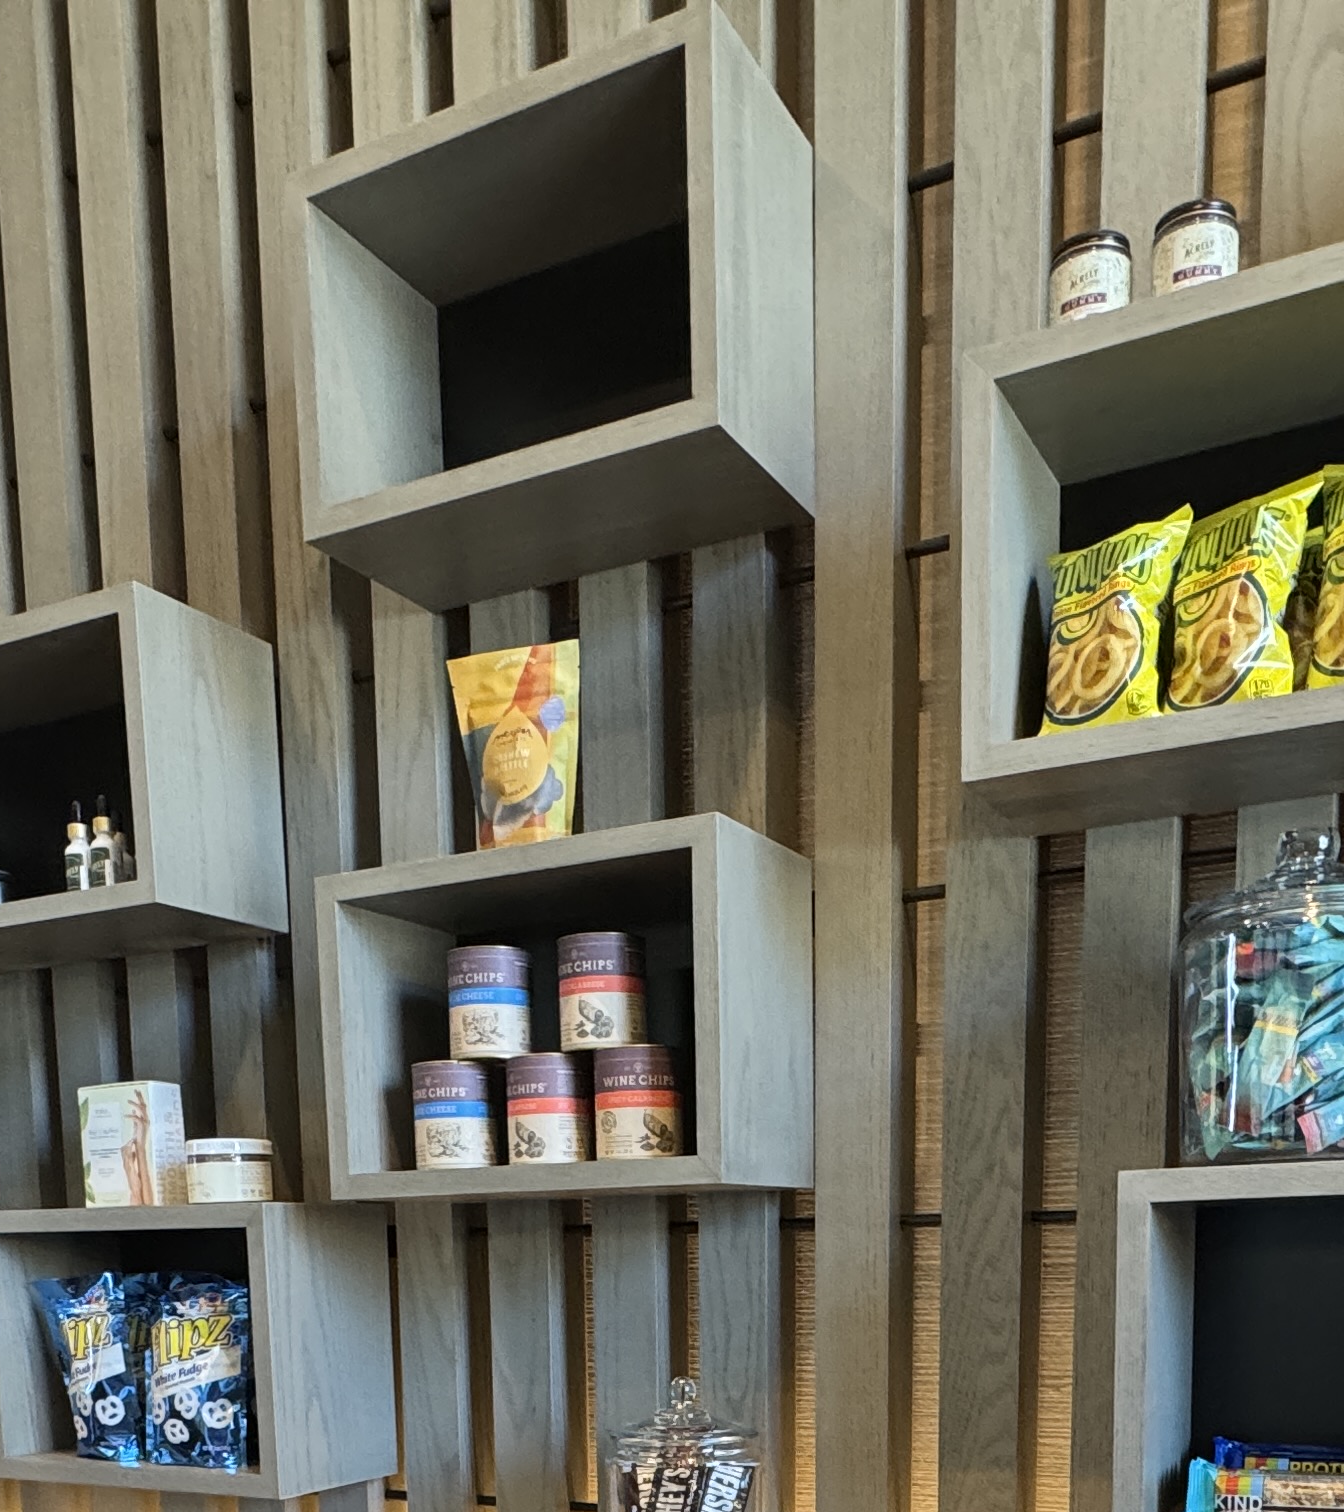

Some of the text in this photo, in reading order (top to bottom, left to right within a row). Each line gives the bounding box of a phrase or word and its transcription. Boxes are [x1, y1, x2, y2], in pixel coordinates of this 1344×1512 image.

[1053, 532, 1168, 600] UNYUNS
[574, 959, 614, 974] CHIPS
[466, 972, 504, 986] CHIPS
[603, 1073, 675, 1088] WINE CHIPS
[428, 1086, 467, 1099] CHIPS
[511, 1082, 546, 1096] CHIPS
[64, 1313, 113, 1361] ipz
[178, 1361, 209, 1379] Fudge
